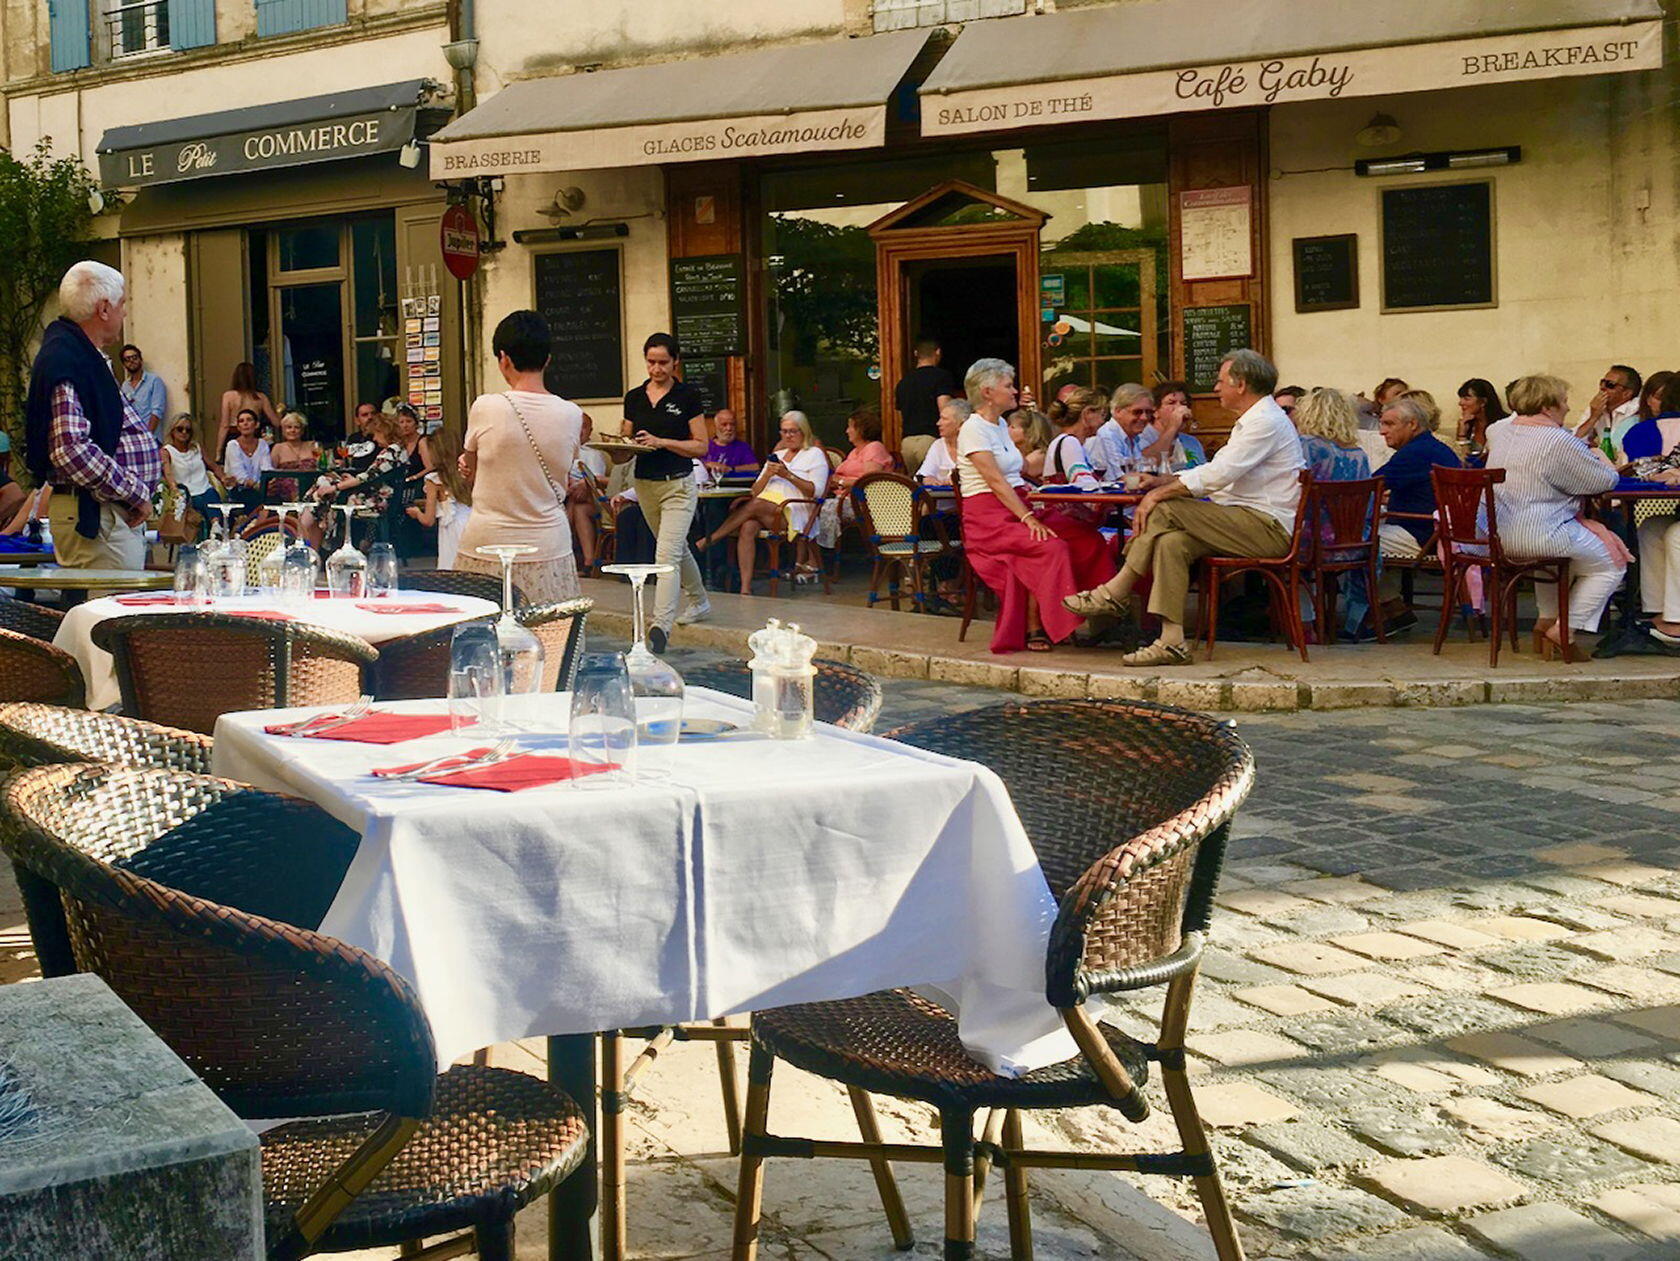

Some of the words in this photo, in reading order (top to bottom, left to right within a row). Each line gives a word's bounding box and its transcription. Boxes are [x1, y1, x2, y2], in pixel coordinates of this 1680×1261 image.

[1462, 41, 1638, 75] BREAKFAST
[1175, 66, 1248, 107] Café
[1258, 57, 1355, 103] Gaby
[938, 104, 1008, 125] SALON
[1014, 100, 1043, 118] DE
[1047, 92, 1093, 114] THÉ
[128, 153, 154, 178] LE
[177, 142, 217, 173] Petit
[244, 120, 380, 160] COMMERCE
[643, 135, 716, 155] GLACES
[721, 118, 867, 149] Scaramouche
[444, 150, 541, 170] BRASSERIE
